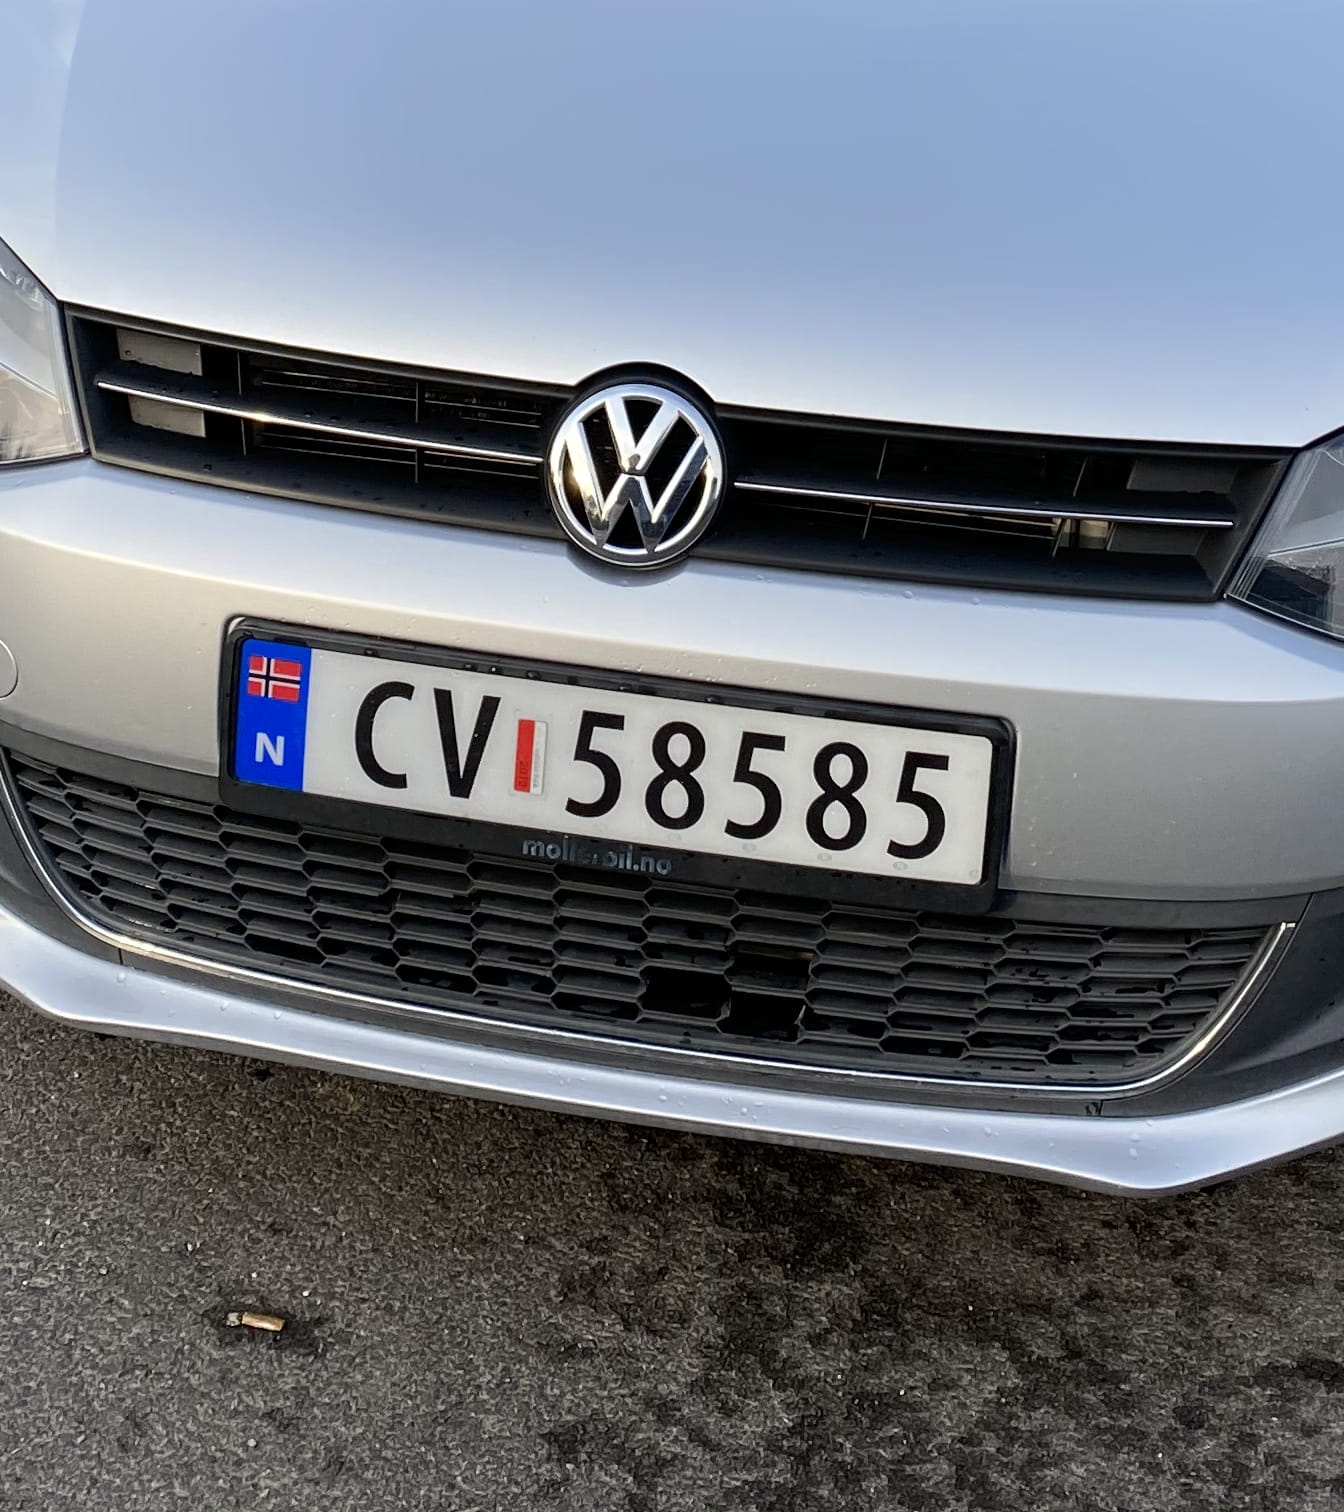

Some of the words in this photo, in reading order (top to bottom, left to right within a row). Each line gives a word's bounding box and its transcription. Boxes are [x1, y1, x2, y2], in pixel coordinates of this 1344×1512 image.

[553, 387, 719, 562] VW
[254, 731, 285, 767] N
[354, 680, 502, 800] CV
[564, 709, 950, 860] 58585
